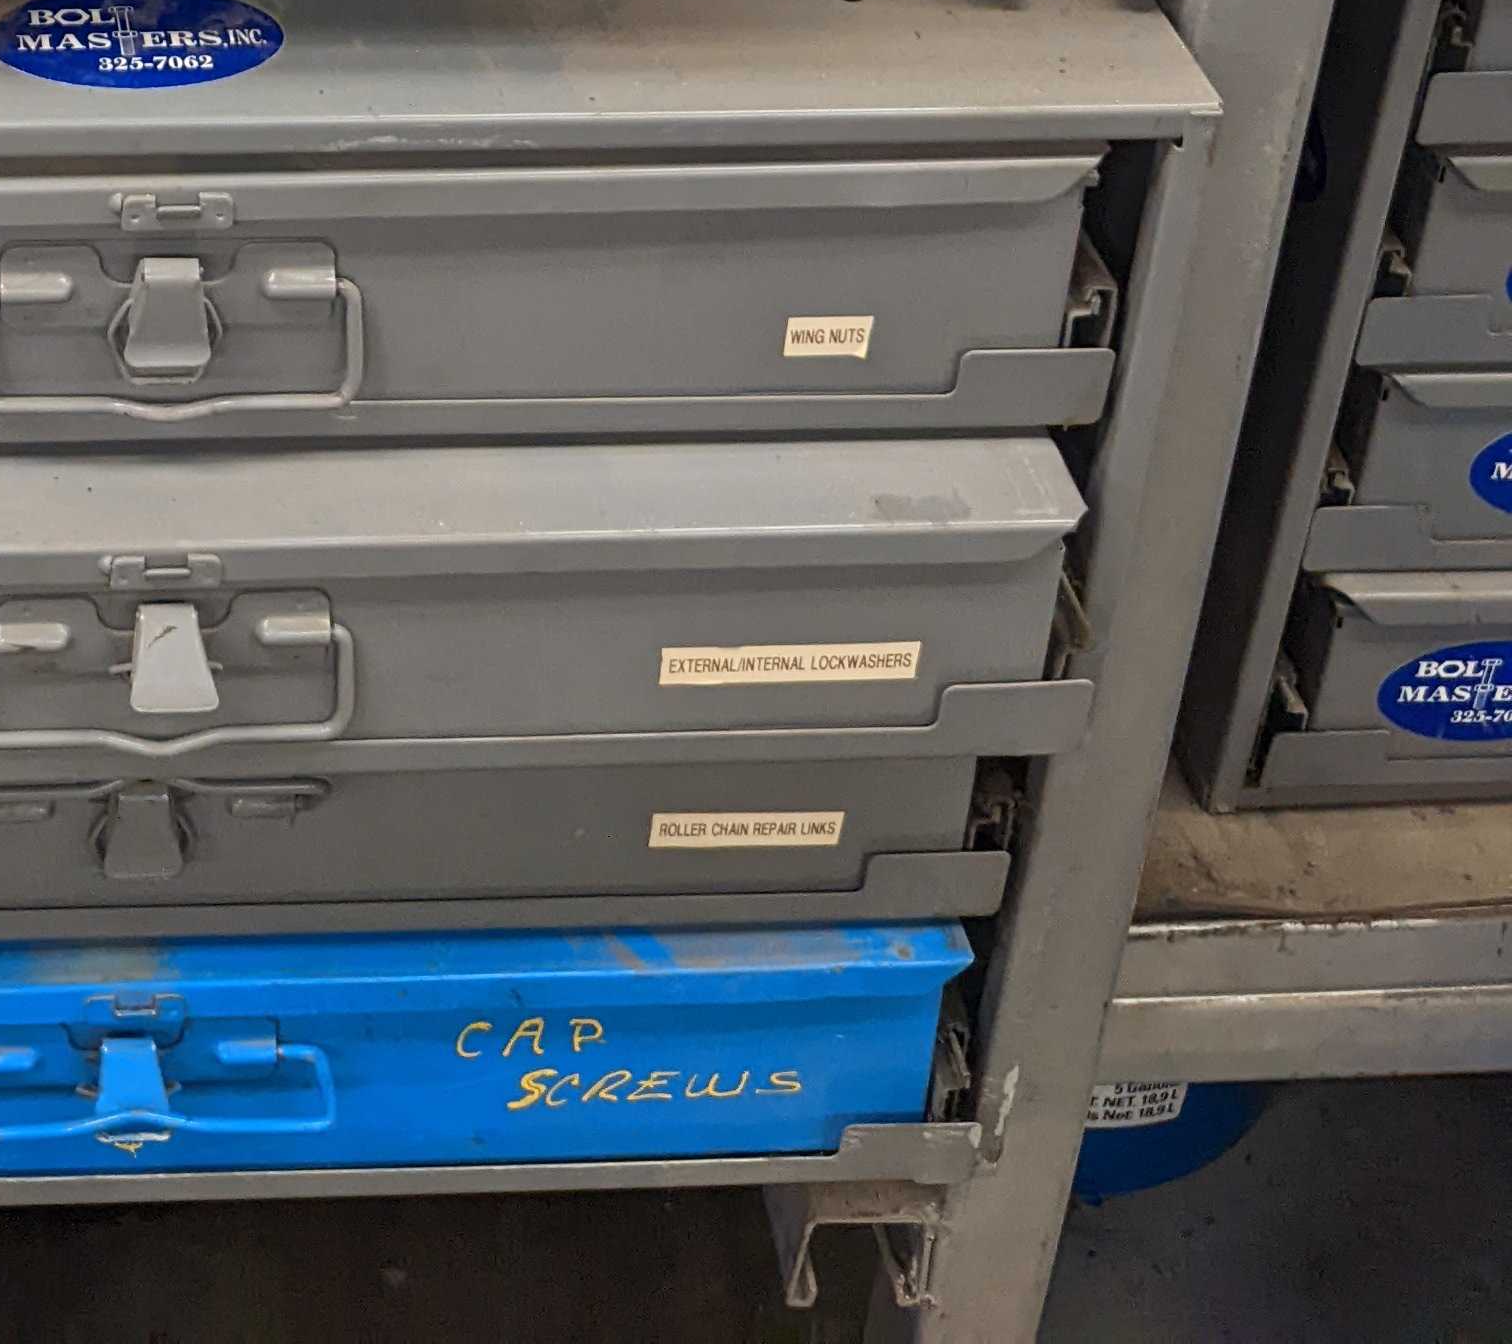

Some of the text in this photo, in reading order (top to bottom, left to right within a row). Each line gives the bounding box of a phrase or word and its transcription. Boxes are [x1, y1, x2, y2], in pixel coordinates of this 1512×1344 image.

[98, 55, 215, 72] 325-7062
[790, 327, 866, 345] WING NUTS
[668, 652, 913, 674] EXTERNAL/INTERNAL LOCKWASHERS
[658, 821, 838, 837] ROLLER CHAIN REPAIR LINKS
[455, 1016, 606, 1059] CAP
[506, 1067, 804, 1111] SCREWS
